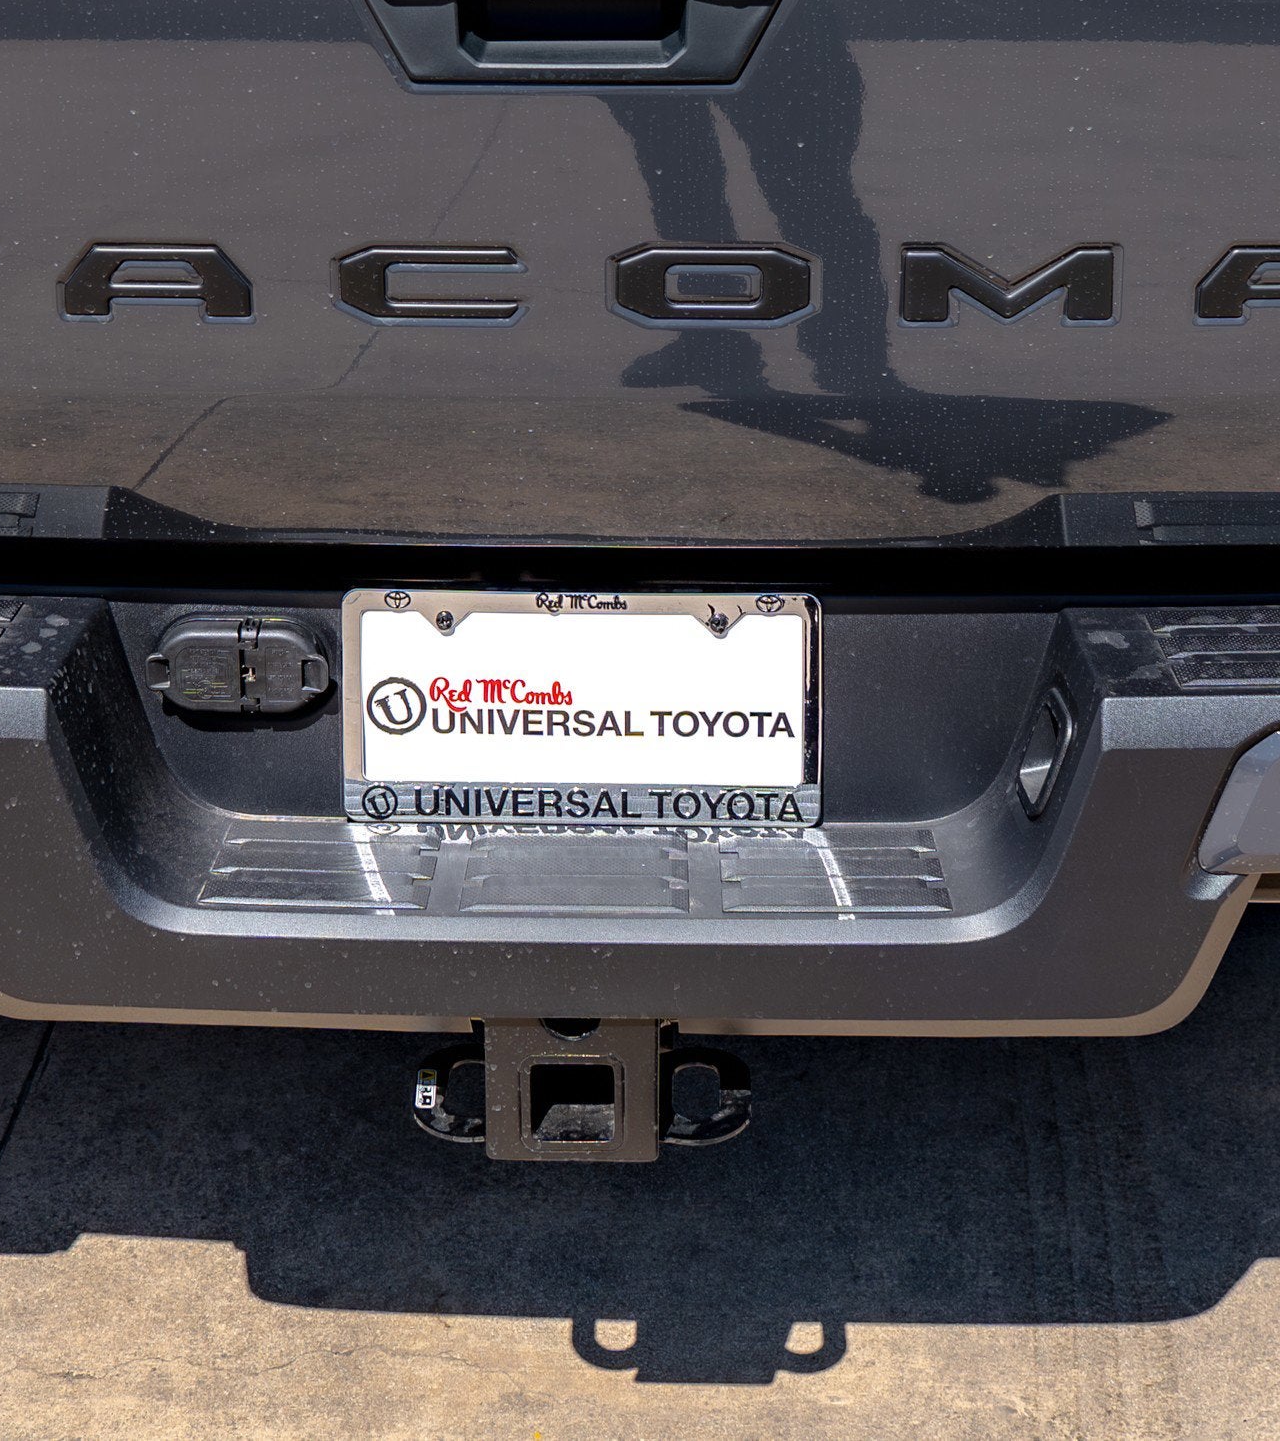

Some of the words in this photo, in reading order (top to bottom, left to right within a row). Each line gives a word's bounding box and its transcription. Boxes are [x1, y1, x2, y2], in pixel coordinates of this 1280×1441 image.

[536, 592, 563, 613] Red
[564, 594, 627, 610] McCombs
[429, 676, 472, 712] Red
[476, 679, 573, 705] McCombs
[432, 708, 644, 738] UNIVERSAL
[650, 710, 795, 738] TOYOTA
[414, 786, 641, 819] UNIVERSAL
[648, 789, 805, 823] TOYOTA
